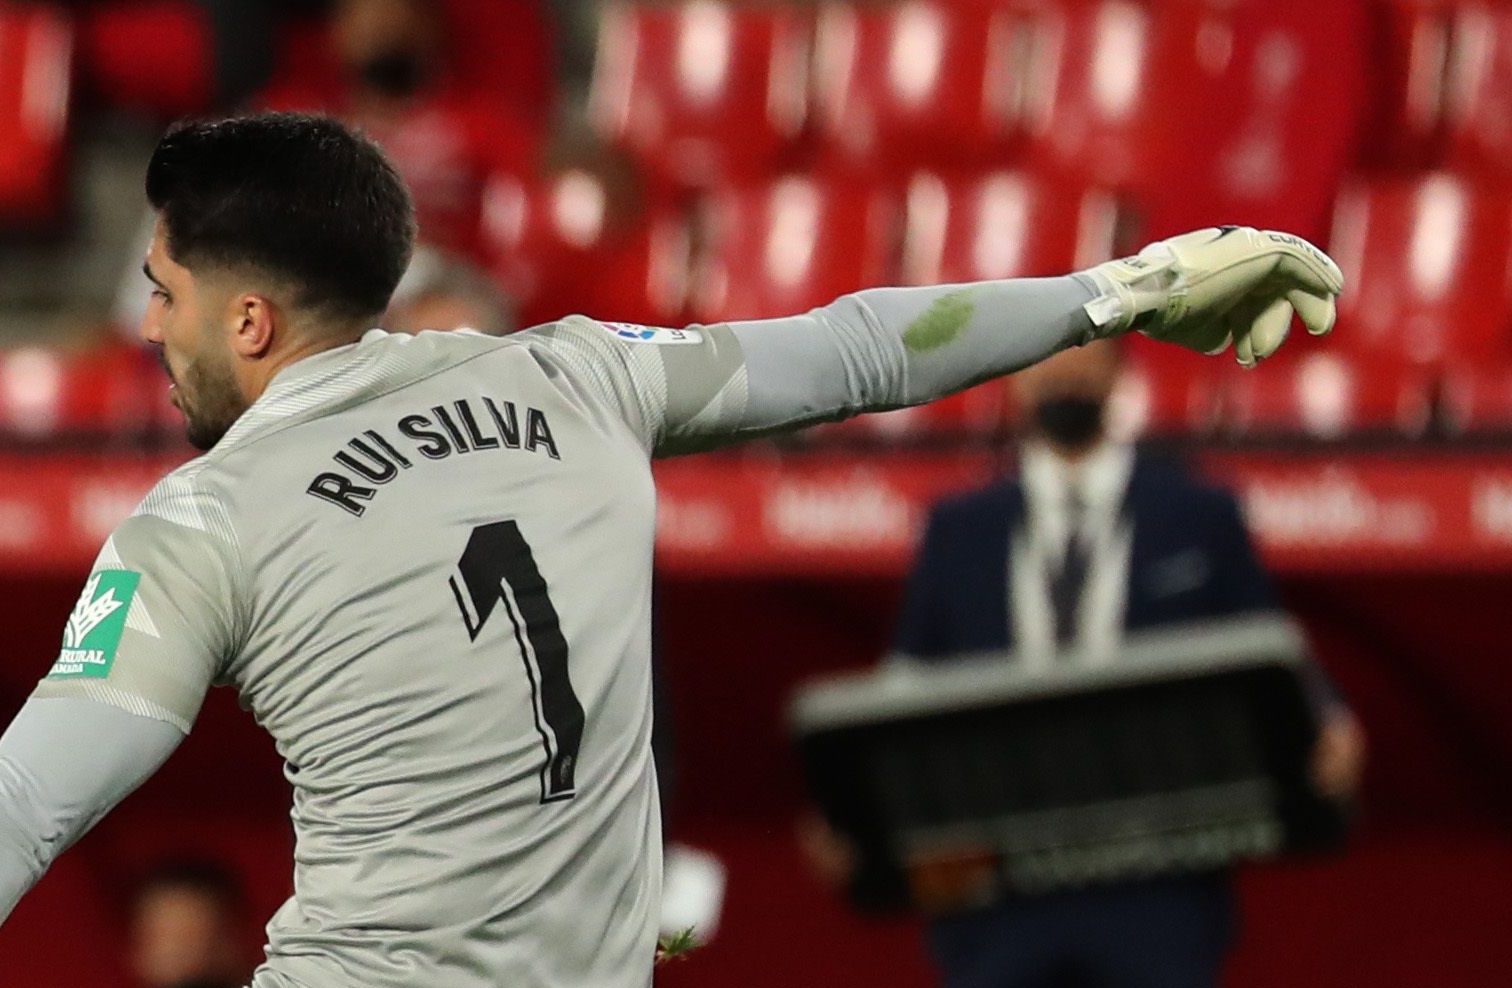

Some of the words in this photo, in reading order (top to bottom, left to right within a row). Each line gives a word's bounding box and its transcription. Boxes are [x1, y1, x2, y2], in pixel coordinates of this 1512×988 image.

[306, 429, 413, 518] RUI
[397, 396, 562, 461] SILVA
[59, 649, 106, 665] RURAL
[448, 519, 586, 805] 1
